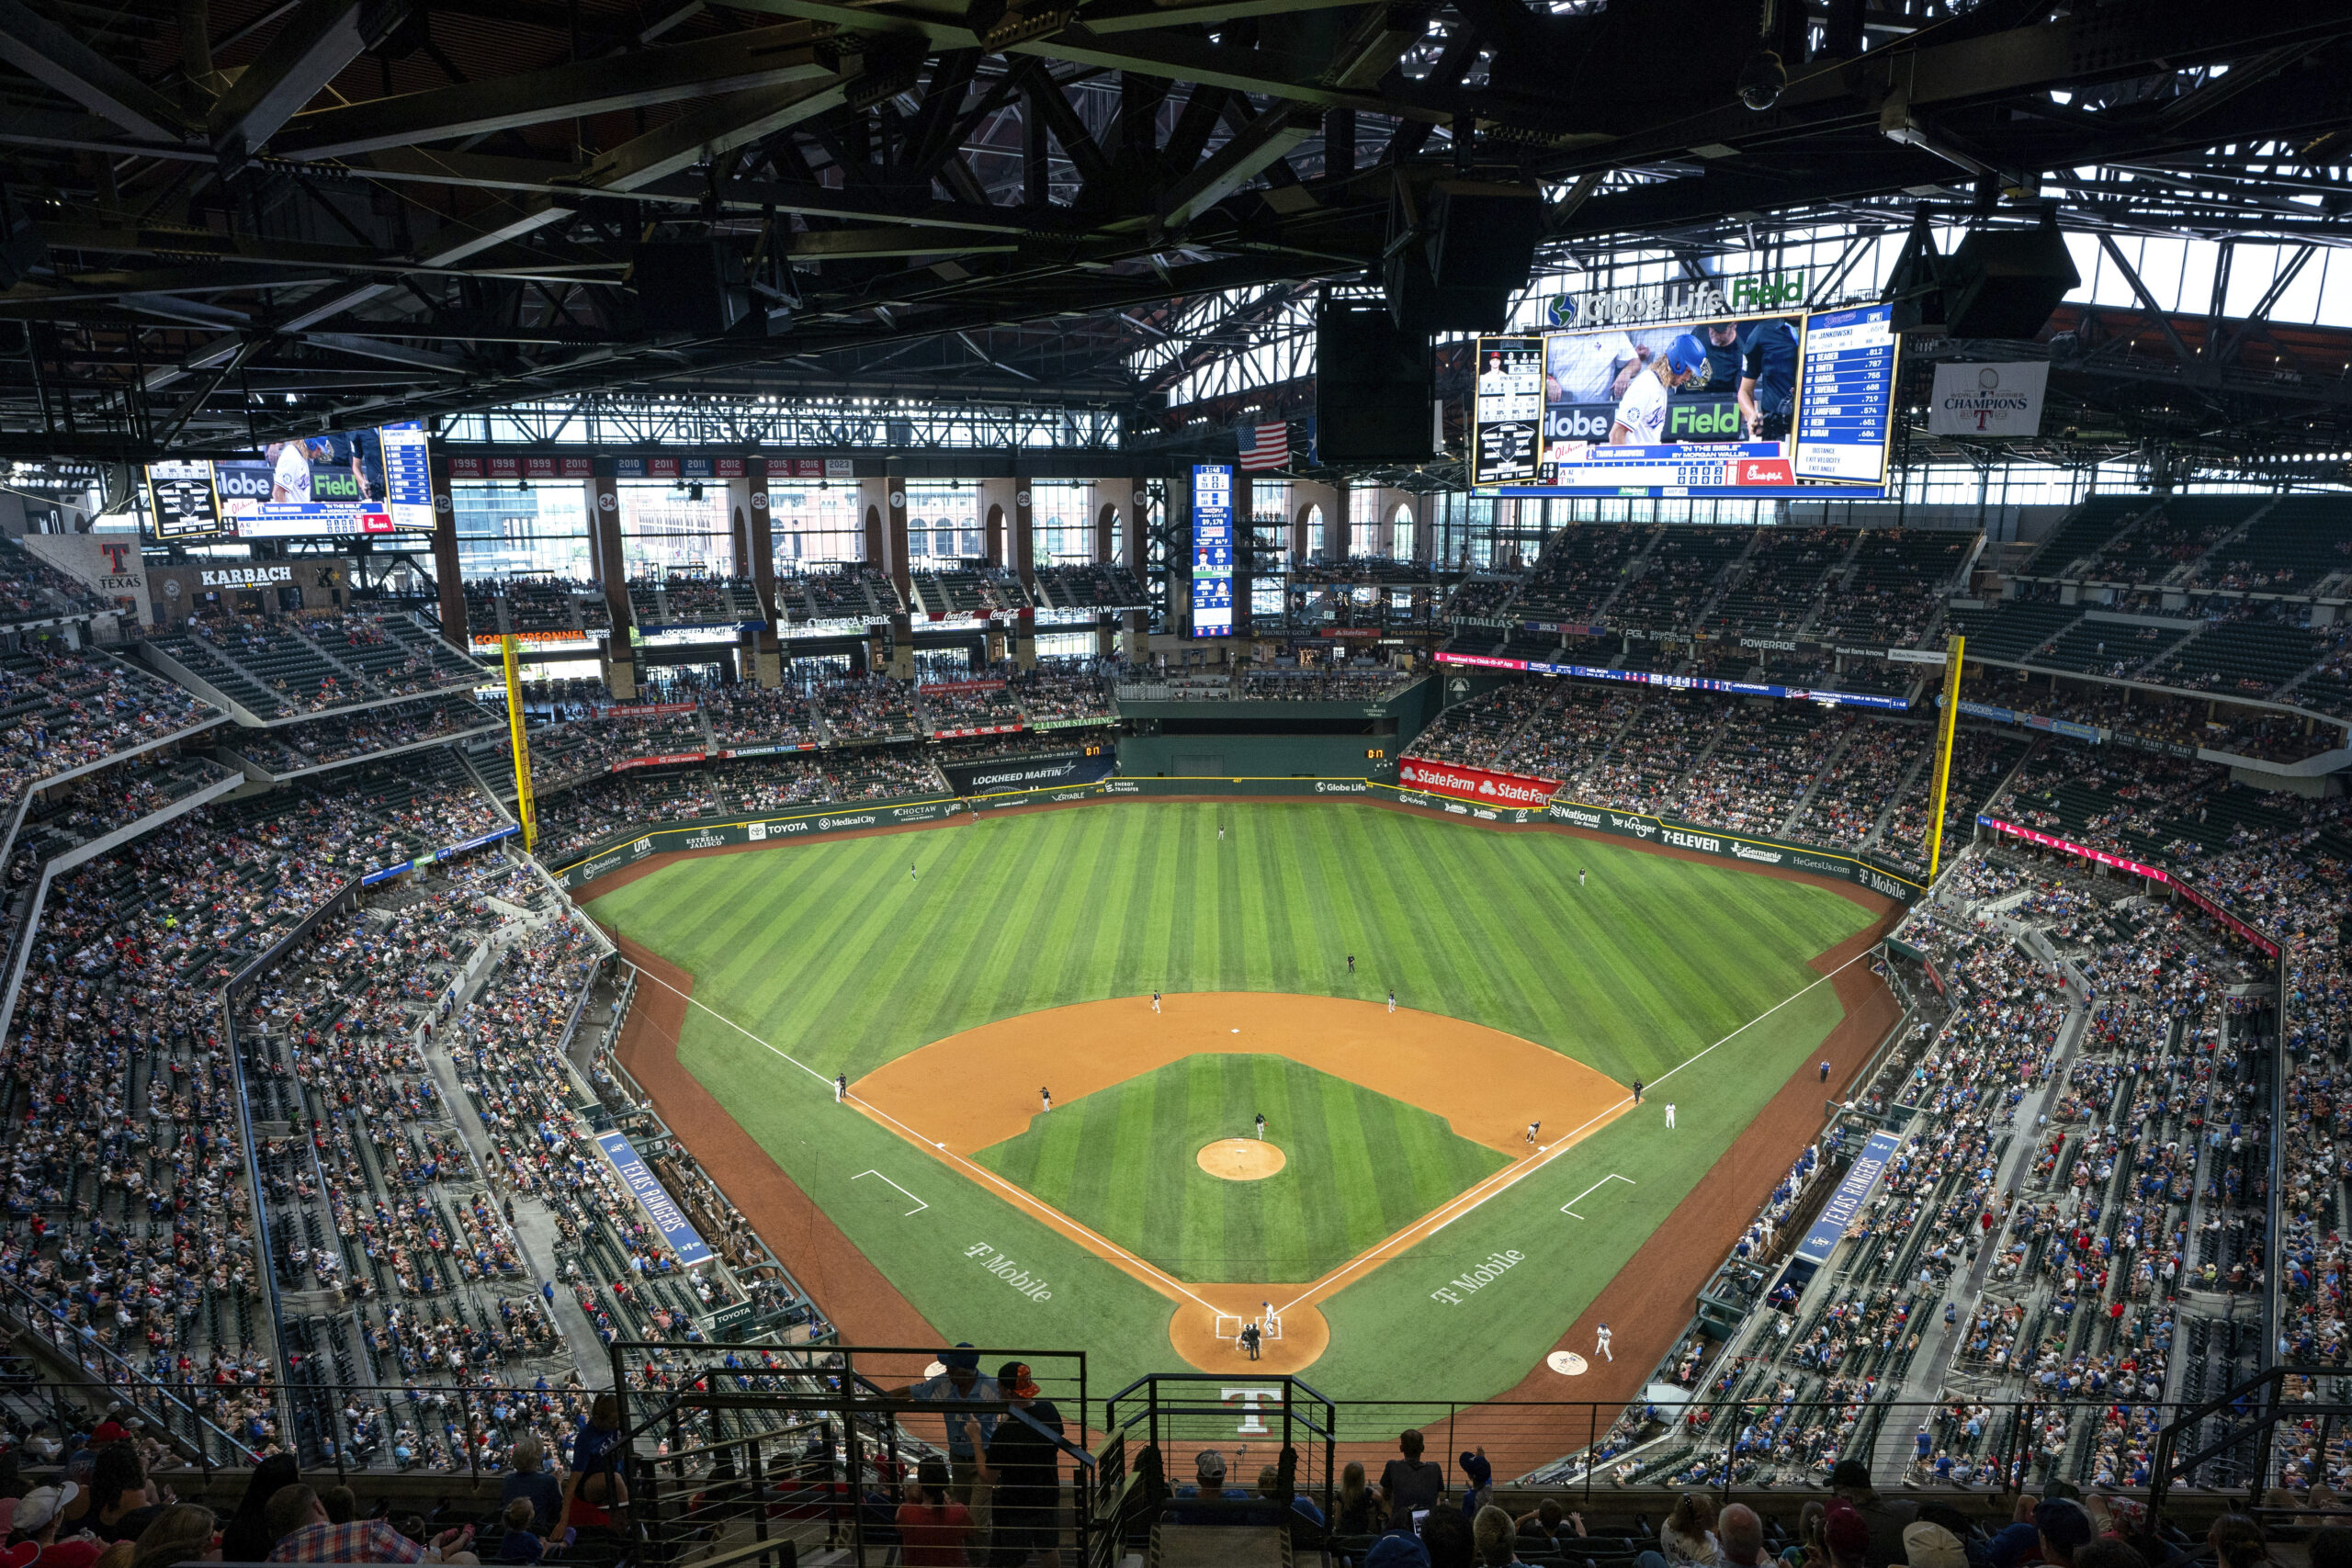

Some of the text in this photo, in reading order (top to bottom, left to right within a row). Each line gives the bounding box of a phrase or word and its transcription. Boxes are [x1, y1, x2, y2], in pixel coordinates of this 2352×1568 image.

[1584, 272, 1804, 321] Globe Life Field
[1819, 329, 1853, 339] JANKOWSKI
[1945, 398, 2028, 410] CHAMPIONS
[1544, 409, 1607, 436] lobe
[1671, 403, 1739, 434] Field
[1974, 410, 1992, 430] T
[454, 459, 477, 468] 1996
[492, 459, 515, 468] 1998
[528, 459, 551, 468] 1999
[566, 459, 587, 468] 2010
[618, 459, 639, 468] 2010
[830, 460, 849, 468] 2023
[217, 472, 270, 494] lobe
[314, 473, 358, 496] Field
[601, 498, 615, 507] 34
[753, 496, 766, 505] 26
[895, 495, 901, 504] 7
[1019, 494, 1030, 502] 29
[1136, 493, 1144, 502] 10
[435, 499, 448, 509] 42
[101, 544, 130, 573] T
[201, 567, 291, 585] KARBACH
[99, 577, 141, 589] TEXAS
[1061, 605, 1113, 615] CHOCTAW
[863, 615, 891, 626] Bank
[1451, 615, 1514, 628] UT DALLAS
[514, 630, 585, 642] PERSONNEL
[662, 626, 732, 636] LOCKHEED MARTIN
[1741, 638, 1796, 650] POWERADE
[1733, 682, 1770, 691] JANKOWSKI
[1957, 701, 1994, 716] ackpocket
[1041, 716, 1114, 728] LUXOR STAFFING
[2115, 733, 2136, 743] PERRY
[2142, 739, 2163, 749] PERRY
[737, 747, 775, 756] GARDENERS
[1368, 750, 1383, 759] 0:17
[2168, 745, 2192, 755] PERRY
[972, 768, 1062, 785] LOCKHEED MARTIN
[1327, 783, 1350, 791] Globe
[897, 806, 936, 816] CHOCTAW
[1561, 807, 1600, 823] National
[831, 815, 876, 827] Medical City
[1624, 817, 1657, 837] Kroger
[768, 822, 808, 834] TOYOTA
[634, 837, 651, 852] UTA
[686, 834, 725, 845] ESTRELLA
[690, 840, 722, 849] JALISCO
[1745, 846, 1781, 859] Germania
[1793, 856, 1850, 874] HeGetsUs.com
[1871, 873, 1905, 900] Mobile
[620, 1160, 686, 1233] TEXAS RANGERS
[1822, 1156, 1882, 1227] TEXAS RANGERS
[1449, 1249, 1525, 1294] Mobile
[979, 1254, 1052, 1303] Mobile
[717, 1306, 751, 1323] TOYOTA
